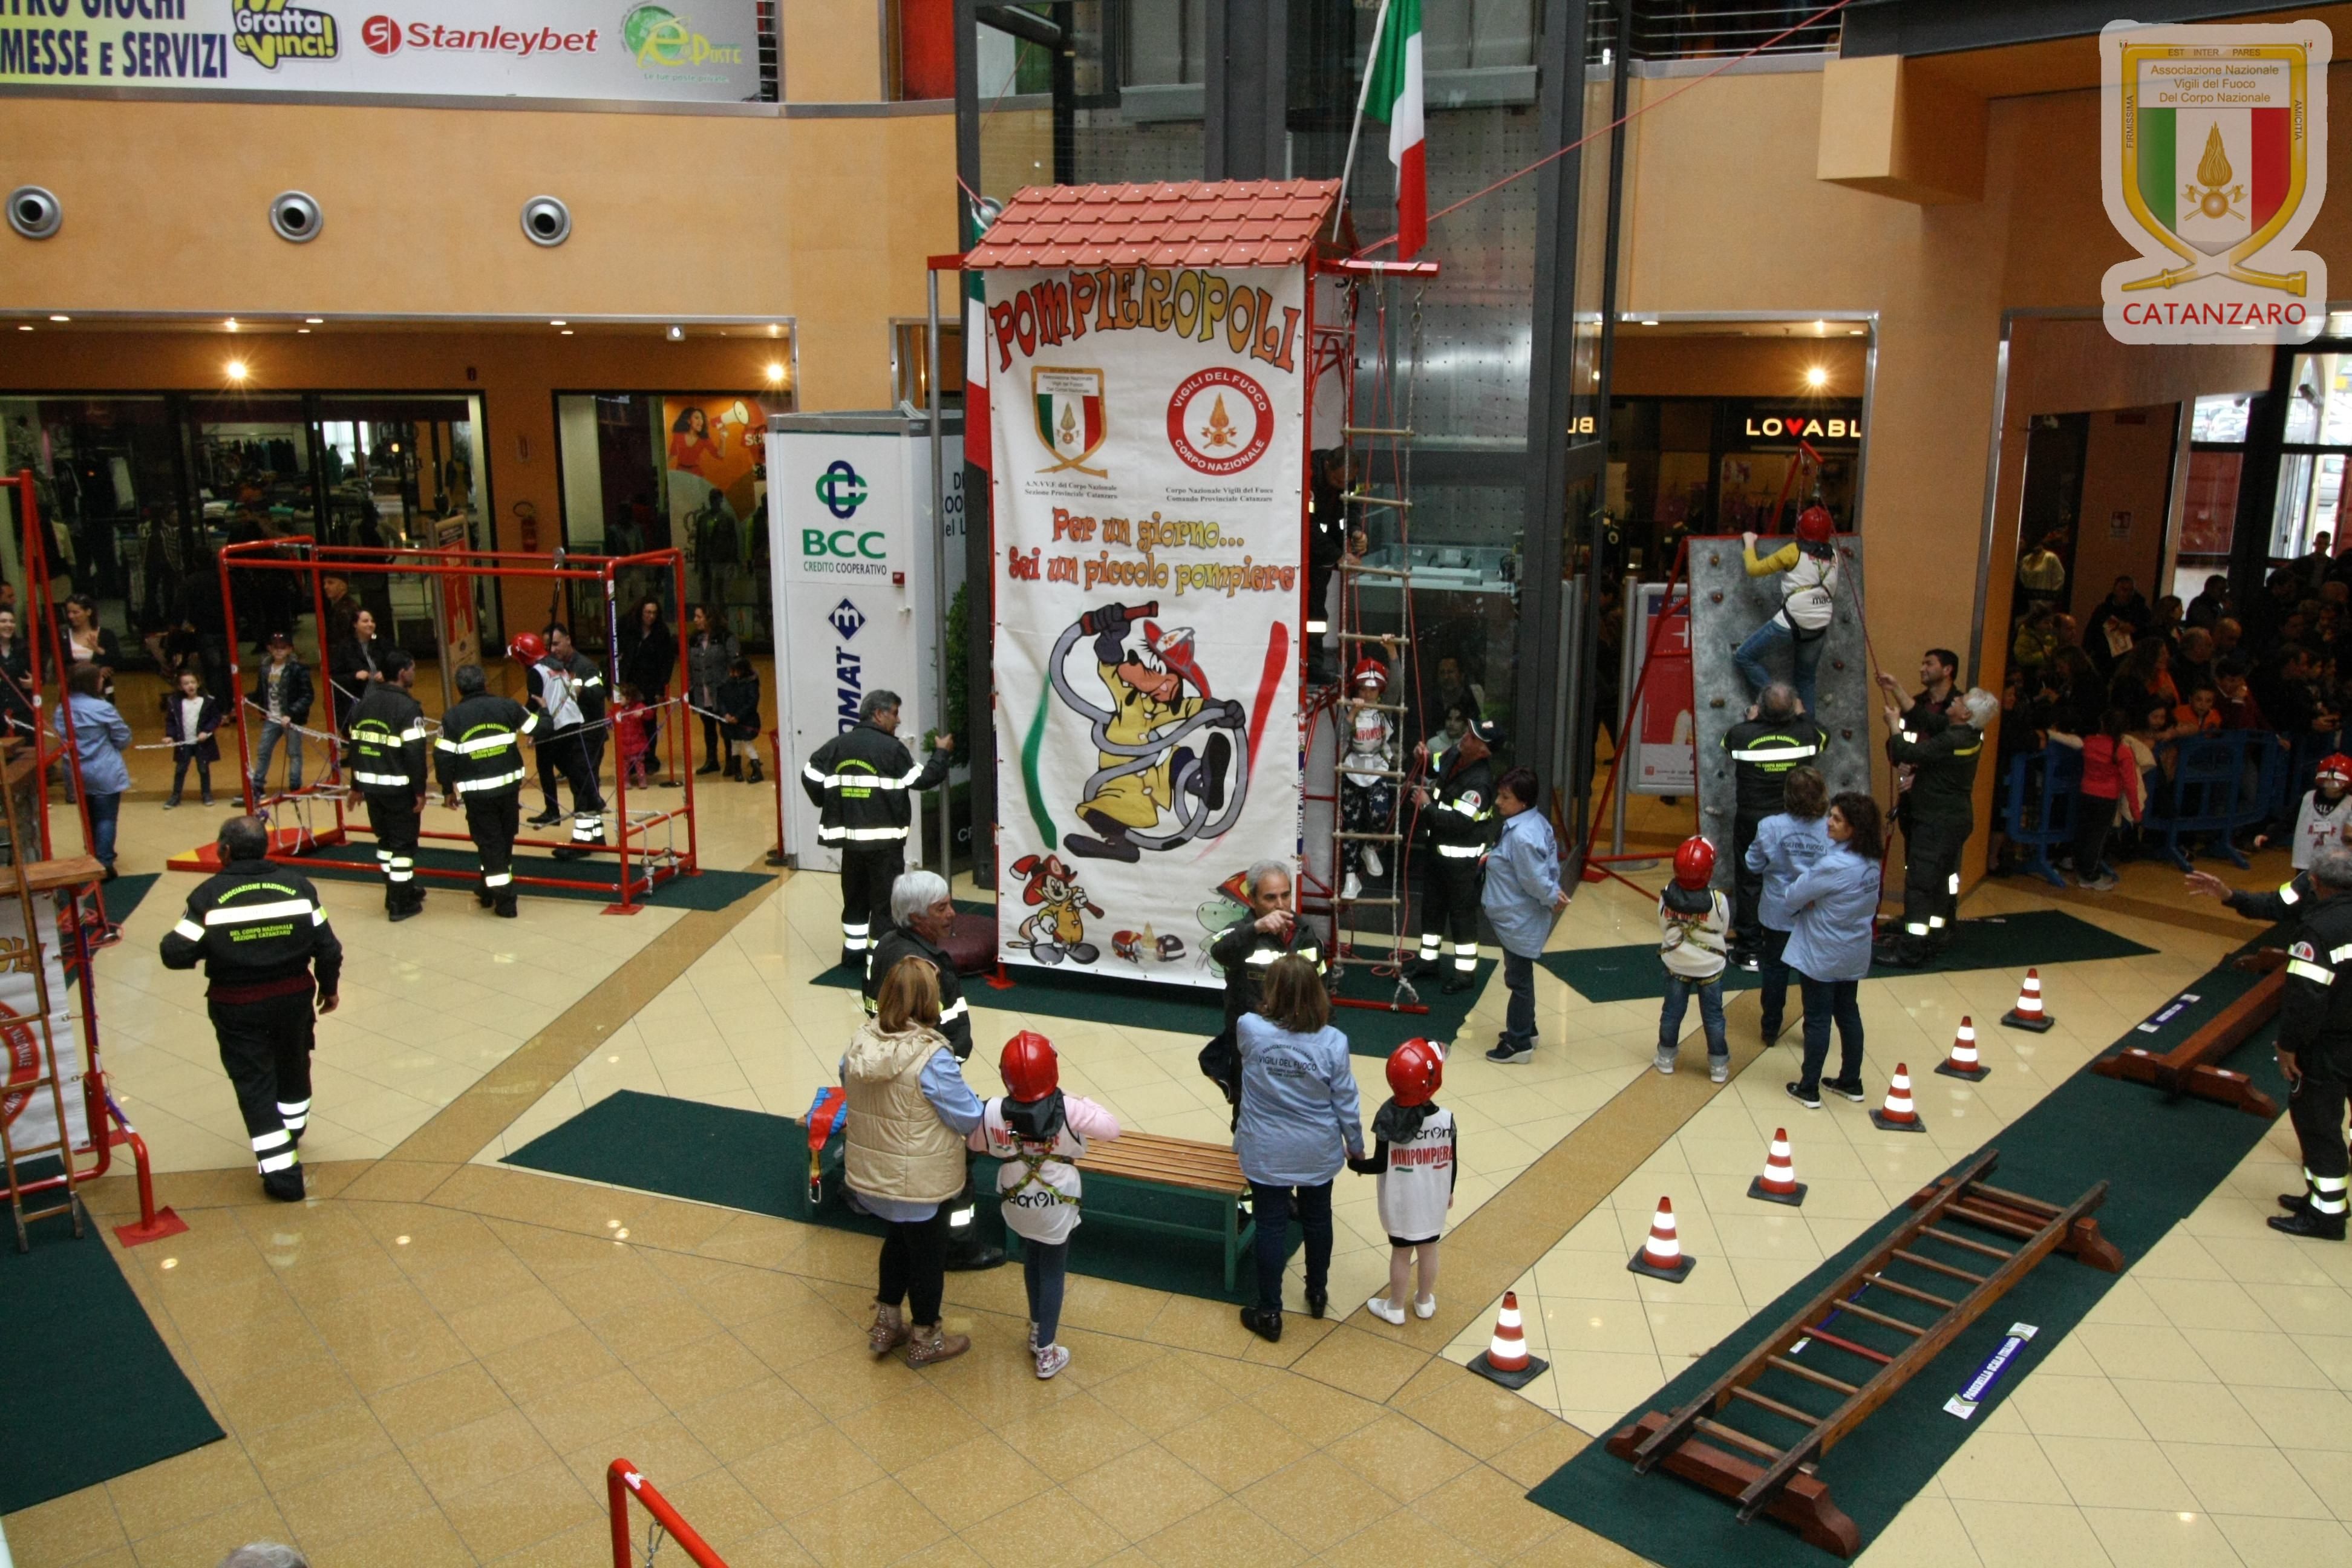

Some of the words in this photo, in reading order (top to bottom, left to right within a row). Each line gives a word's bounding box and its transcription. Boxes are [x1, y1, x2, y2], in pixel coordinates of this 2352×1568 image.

[237, 9, 323, 34] Gratta
[100, 42, 113, 76] E
[122, 31, 227, 79] SERVIZI
[406, 22, 598, 56] Stanleybet
[988, 265, 1301, 373] POMPIEROPOLI
[1174, 377, 1203, 407] VIGILI
[1205, 372, 1229, 382] DEL
[1232, 374, 1266, 411] FUOCO
[1175, 439, 1206, 468] CORPO
[1207, 439, 1264, 471] NAZIONALE
[802, 529, 886, 559] BCC
[1051, 506, 1097, 542] Per
[1102, 516, 1132, 547] un
[1137, 511, 1244, 552] giorno...
[803, 561, 834, 573] CREDITO
[835, 562, 887, 575] COOPERATIVO
[1008, 546, 1042, 581] Sei
[1047, 555, 1079, 584] un
[1084, 550, 1169, 591] piccolo
[1175, 555, 1295, 598] pompiere
[1259, 1054, 1278, 1065] VIGILI
[1279, 1059, 1293, 1067] DEL
[1293, 1060, 1317, 1071] FUOCO
[1426, 1060, 1433, 1070] 8
